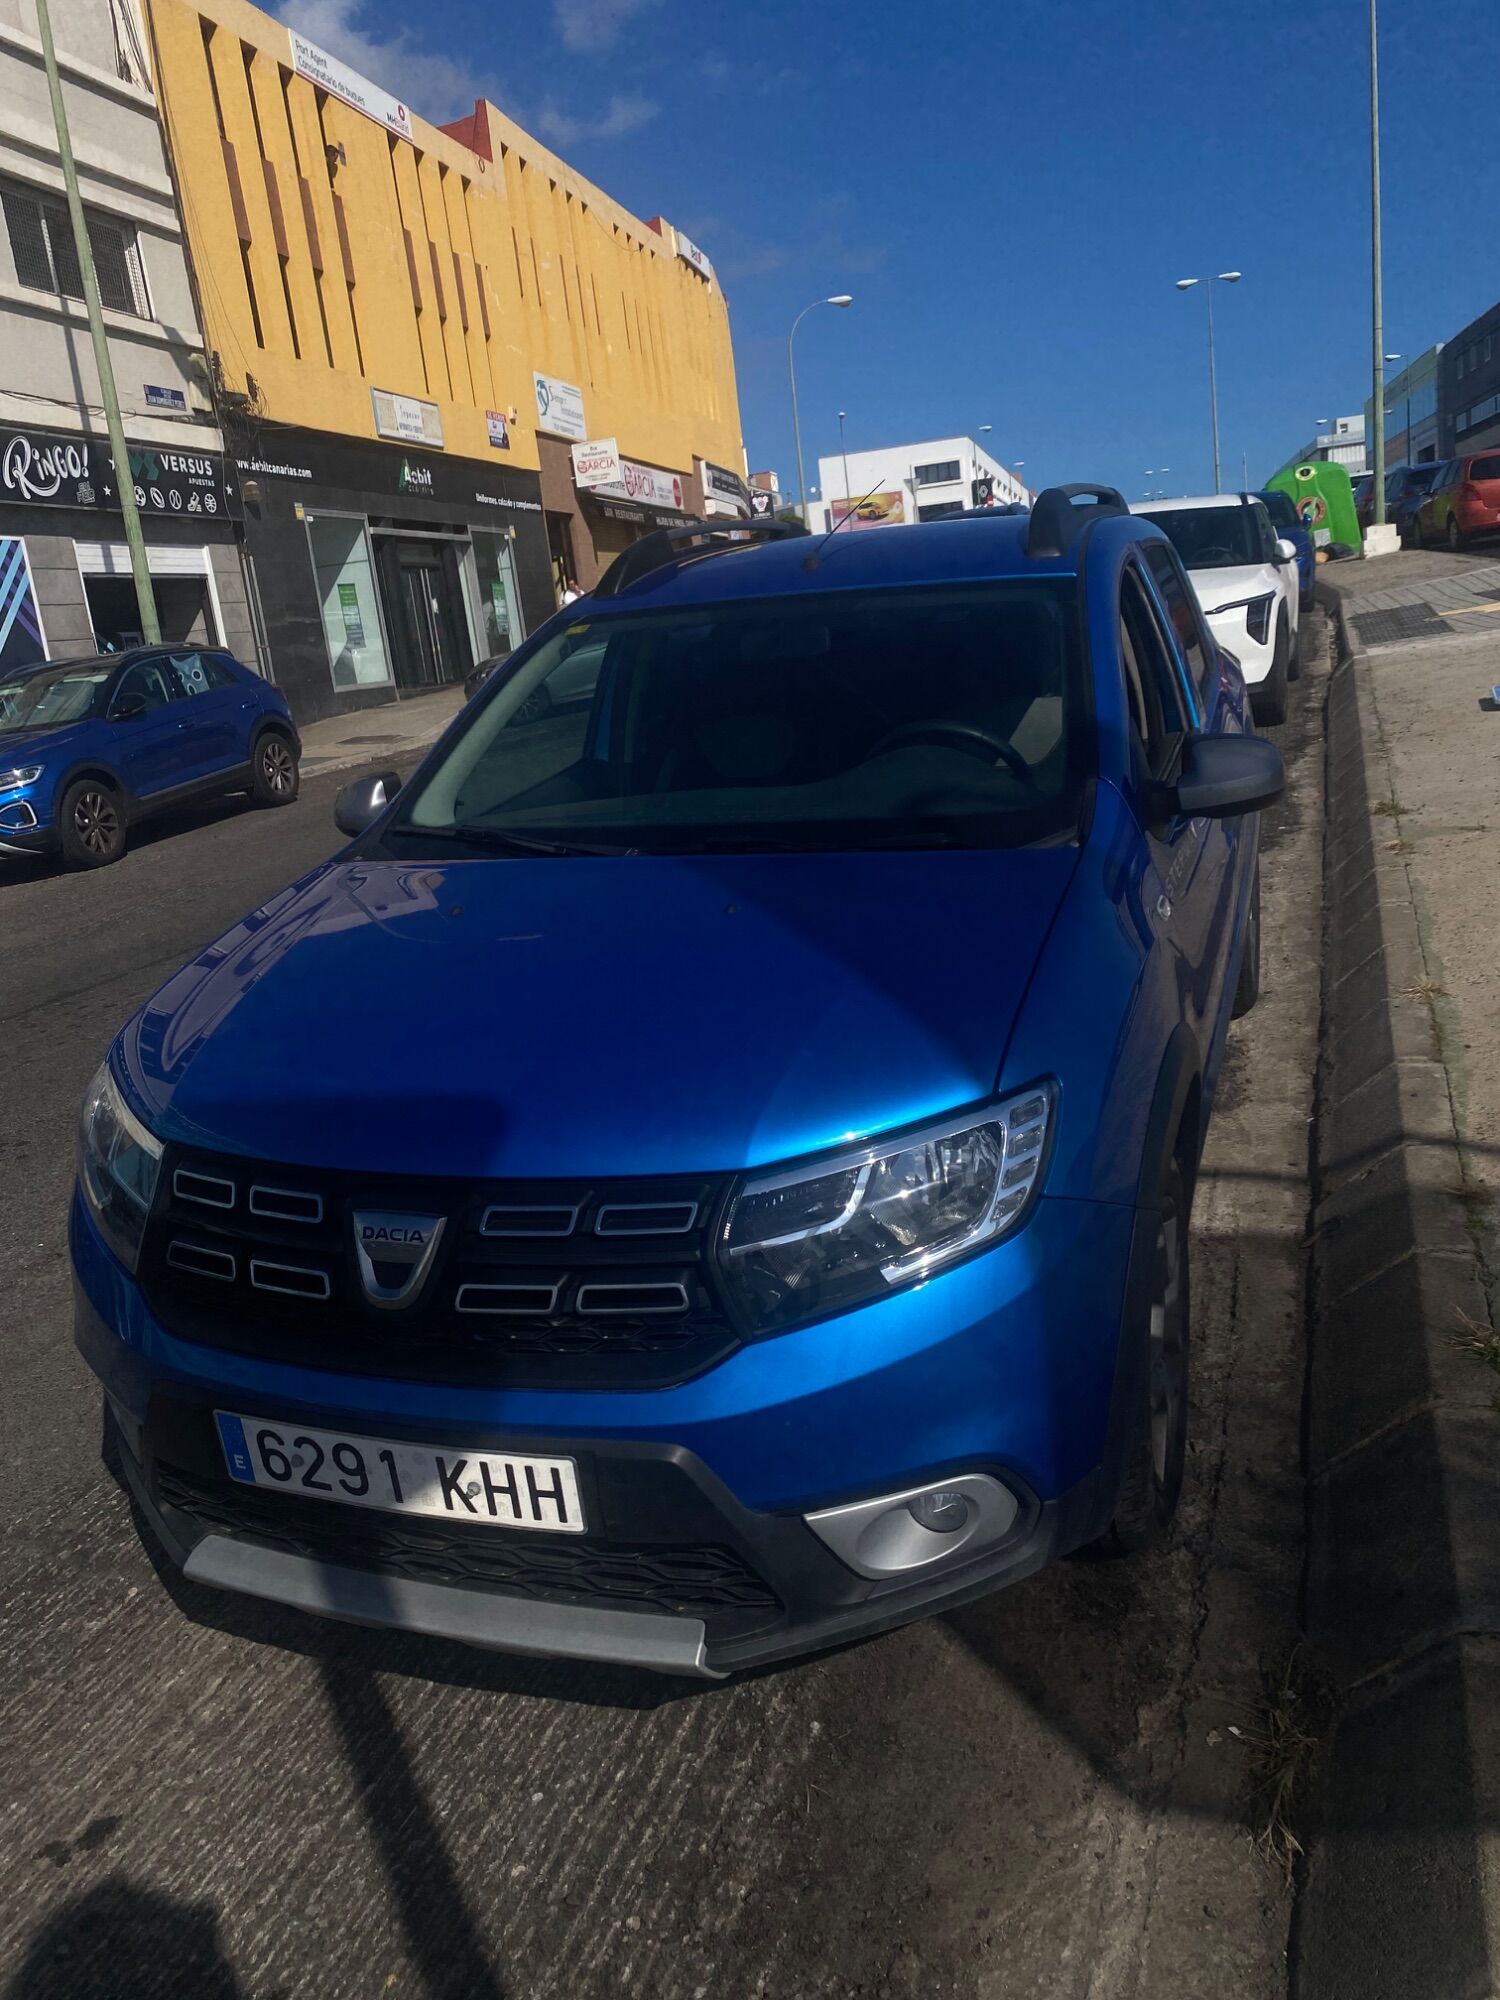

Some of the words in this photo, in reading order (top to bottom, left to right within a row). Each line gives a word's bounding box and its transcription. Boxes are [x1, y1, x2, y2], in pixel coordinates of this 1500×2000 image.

[295, 39, 309, 57] Port
[310, 50, 328, 69] Agent
[160, 454, 213, 476] VERSUS
[188, 477, 215, 487] APUESTAS
[362, 1226, 425, 1243] DACIA
[233, 1453, 247, 1470] E
[256, 1429, 404, 1504] 6291
[435, 1456, 568, 1523] KHH
